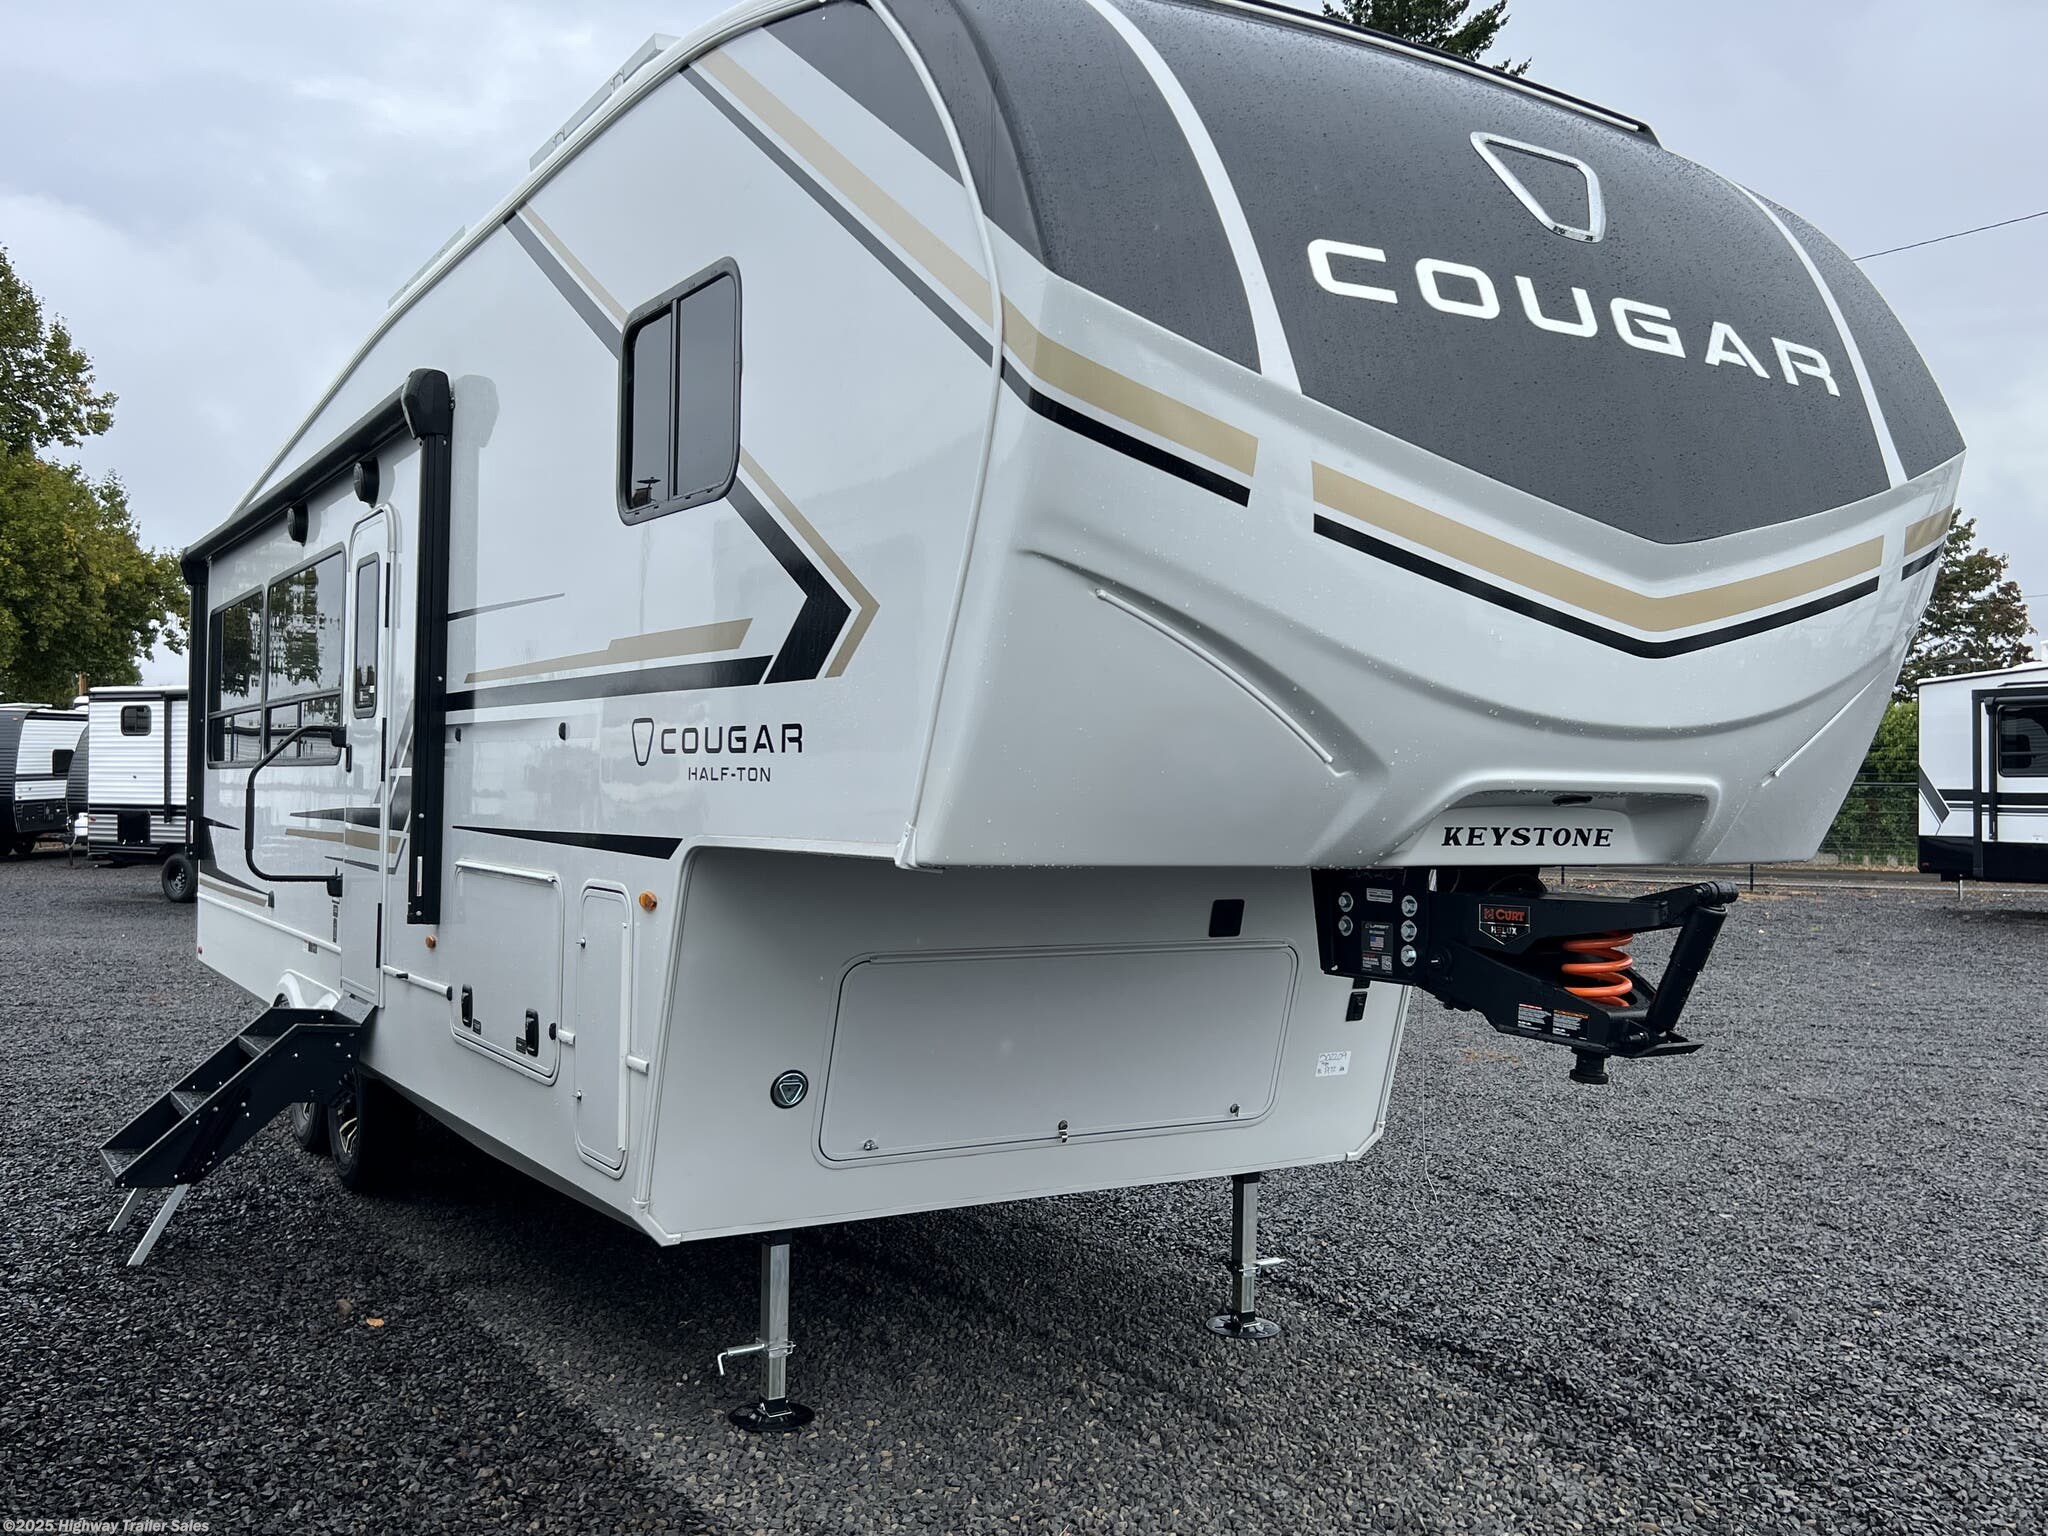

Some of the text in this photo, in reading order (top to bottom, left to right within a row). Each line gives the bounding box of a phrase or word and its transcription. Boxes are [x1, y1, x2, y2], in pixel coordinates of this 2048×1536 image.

[1307, 238, 1841, 397] COUGAR
[661, 723, 803, 754] COUGAR
[688, 766, 771, 782] HALF-TON
[1441, 826, 1614, 847] KEYSTONE
[1495, 908, 1525, 921] CURT
